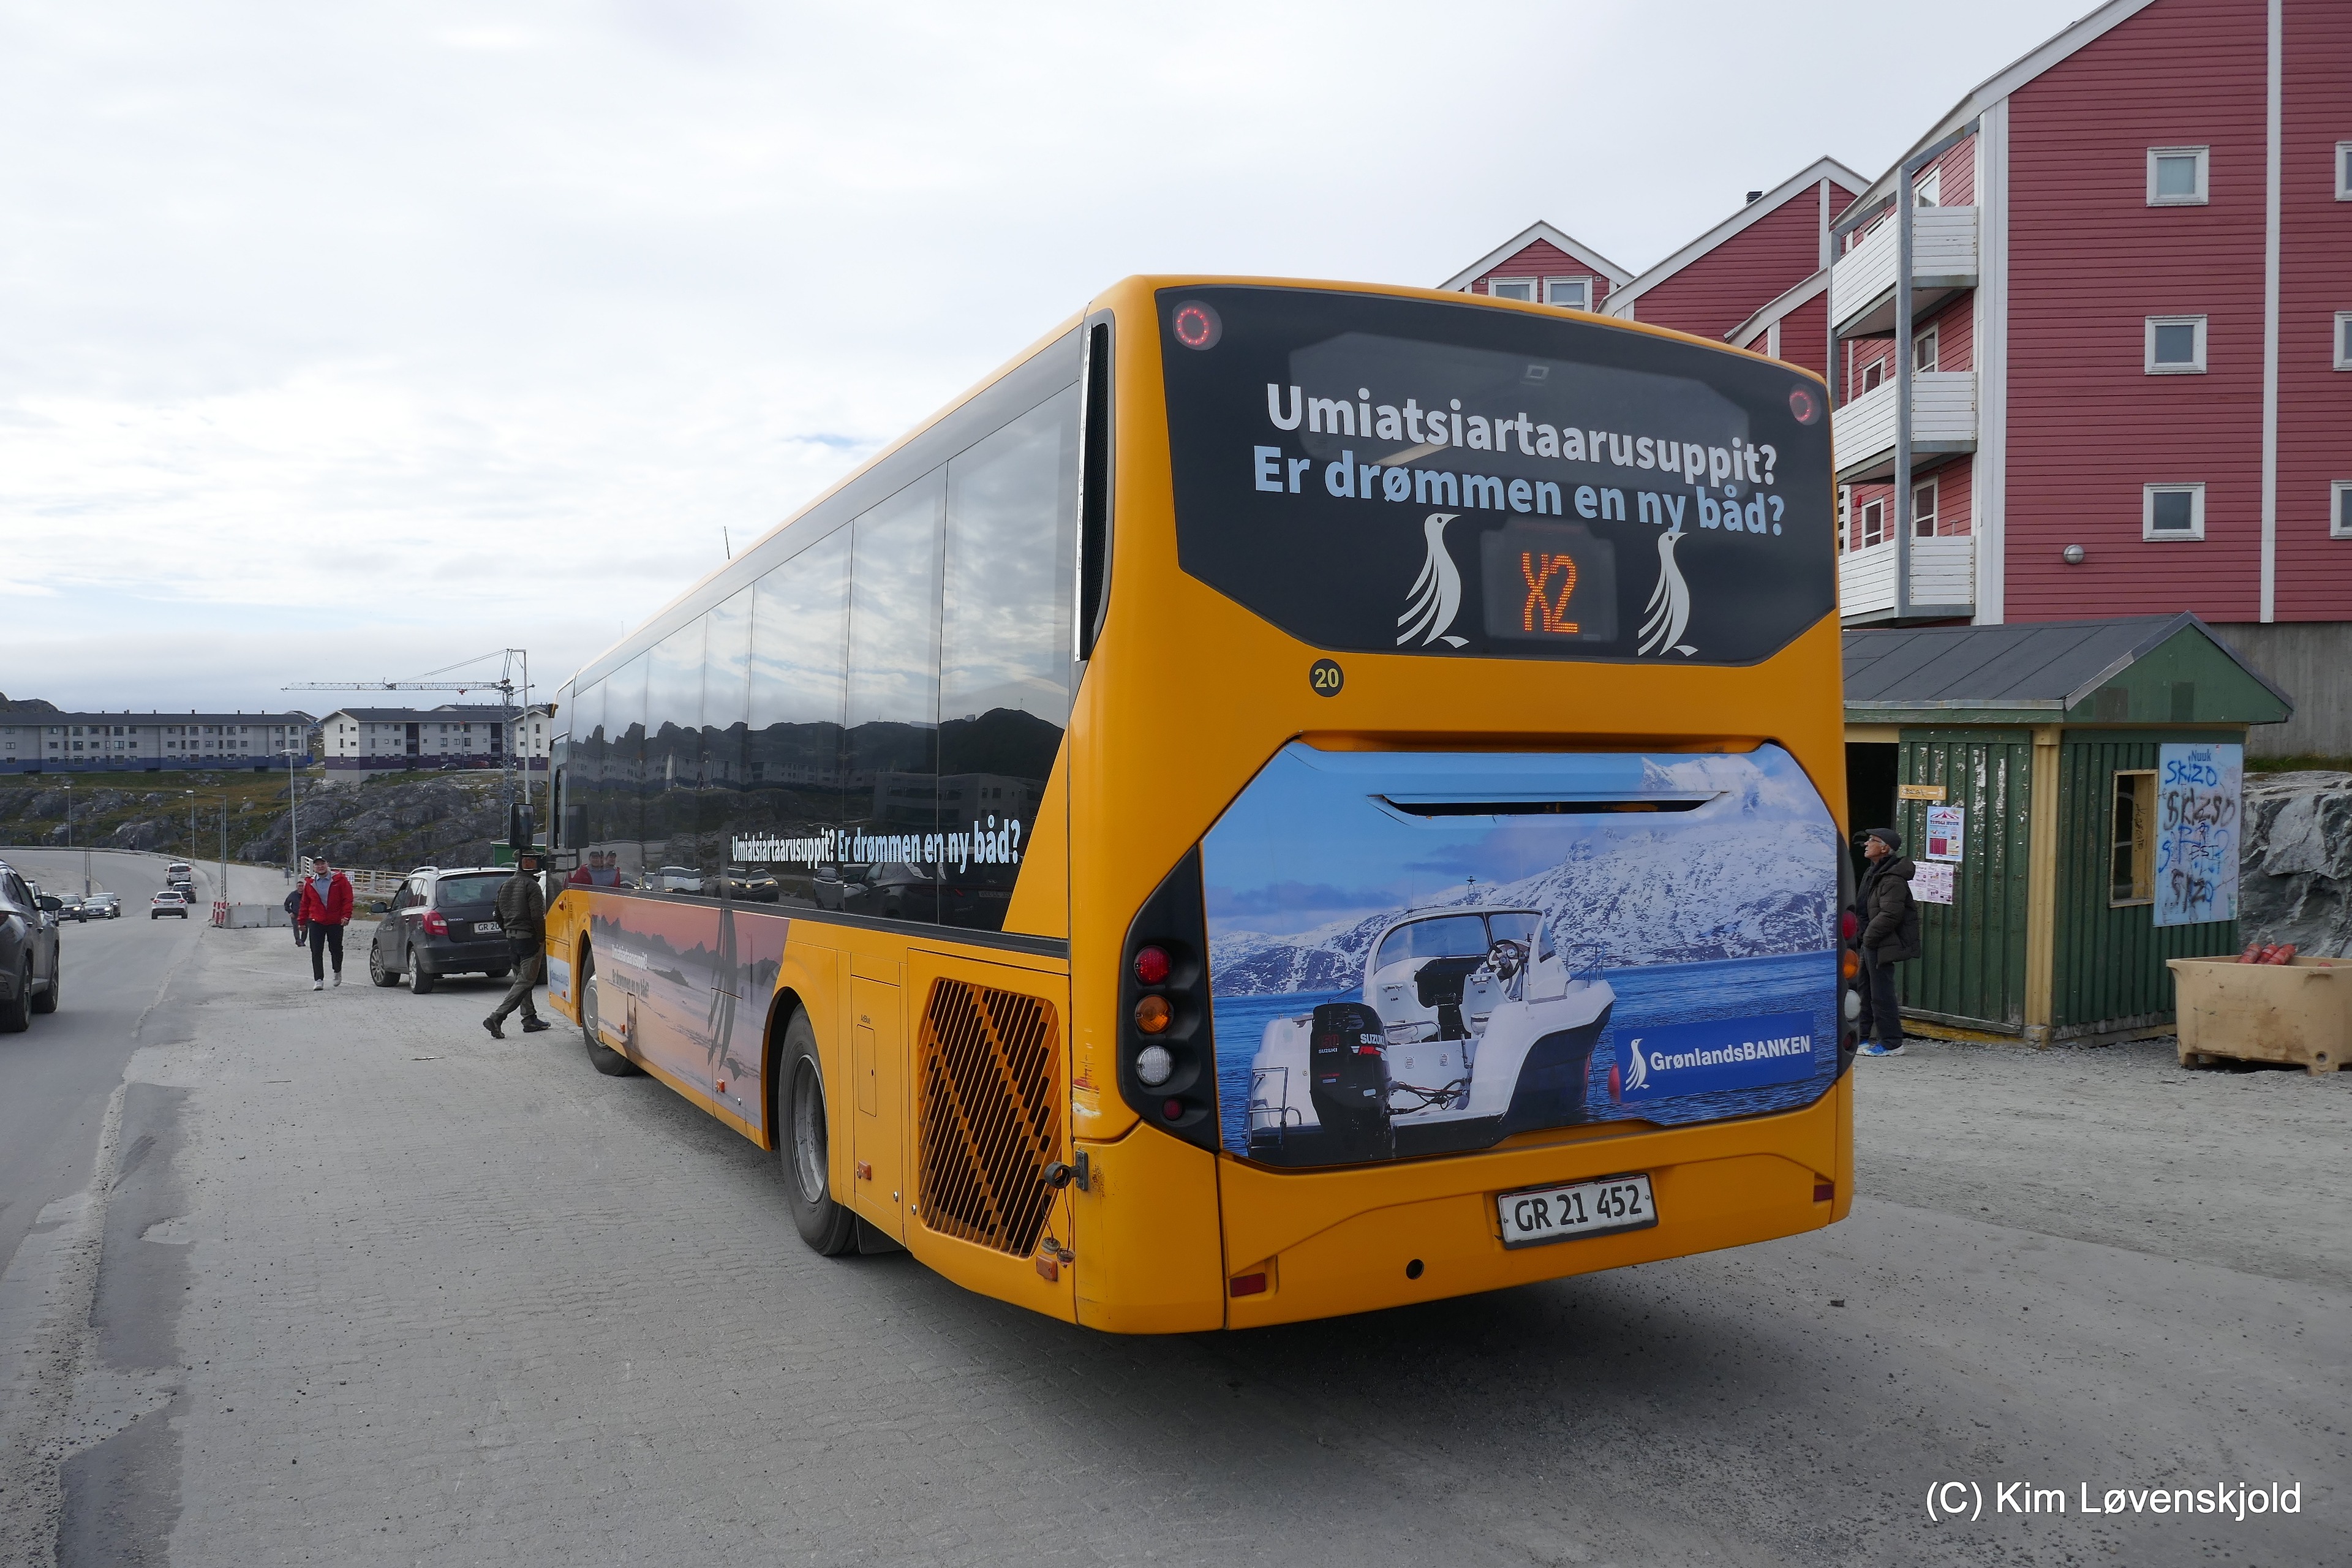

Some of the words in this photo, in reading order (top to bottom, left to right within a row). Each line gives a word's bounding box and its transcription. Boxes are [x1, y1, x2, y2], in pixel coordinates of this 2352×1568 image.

[1267, 383, 1777, 487] Umiatsiartaarusuppit?
[1253, 445, 1310, 494] Er
[1325, 450, 1562, 516] drømmen
[1574, 484, 1624, 522] en
[1638, 492, 1686, 533] ny
[1697, 484, 1785, 537] båd?
[1522, 552, 1578, 633] X2
[1314, 668, 1340, 688] 20
[2191, 748, 2212, 762] Nuuk
[732, 827, 835, 869] Umiatsiartaarusuppit?
[838, 829, 851, 862] Er
[853, 827, 921, 864] drømmen
[924, 832, 944, 864] en
[948, 832, 970, 875] ny
[974, 814, 1021, 864] båd?
[1360, 1033, 1385, 1045] SUZUKI
[1650, 1035, 1811, 1071] GrønlandsBANKEN
[1515, 1197, 1553, 1231] GR
[1556, 1192, 1588, 1226] 21
[1596, 1184, 1642, 1218] 452
